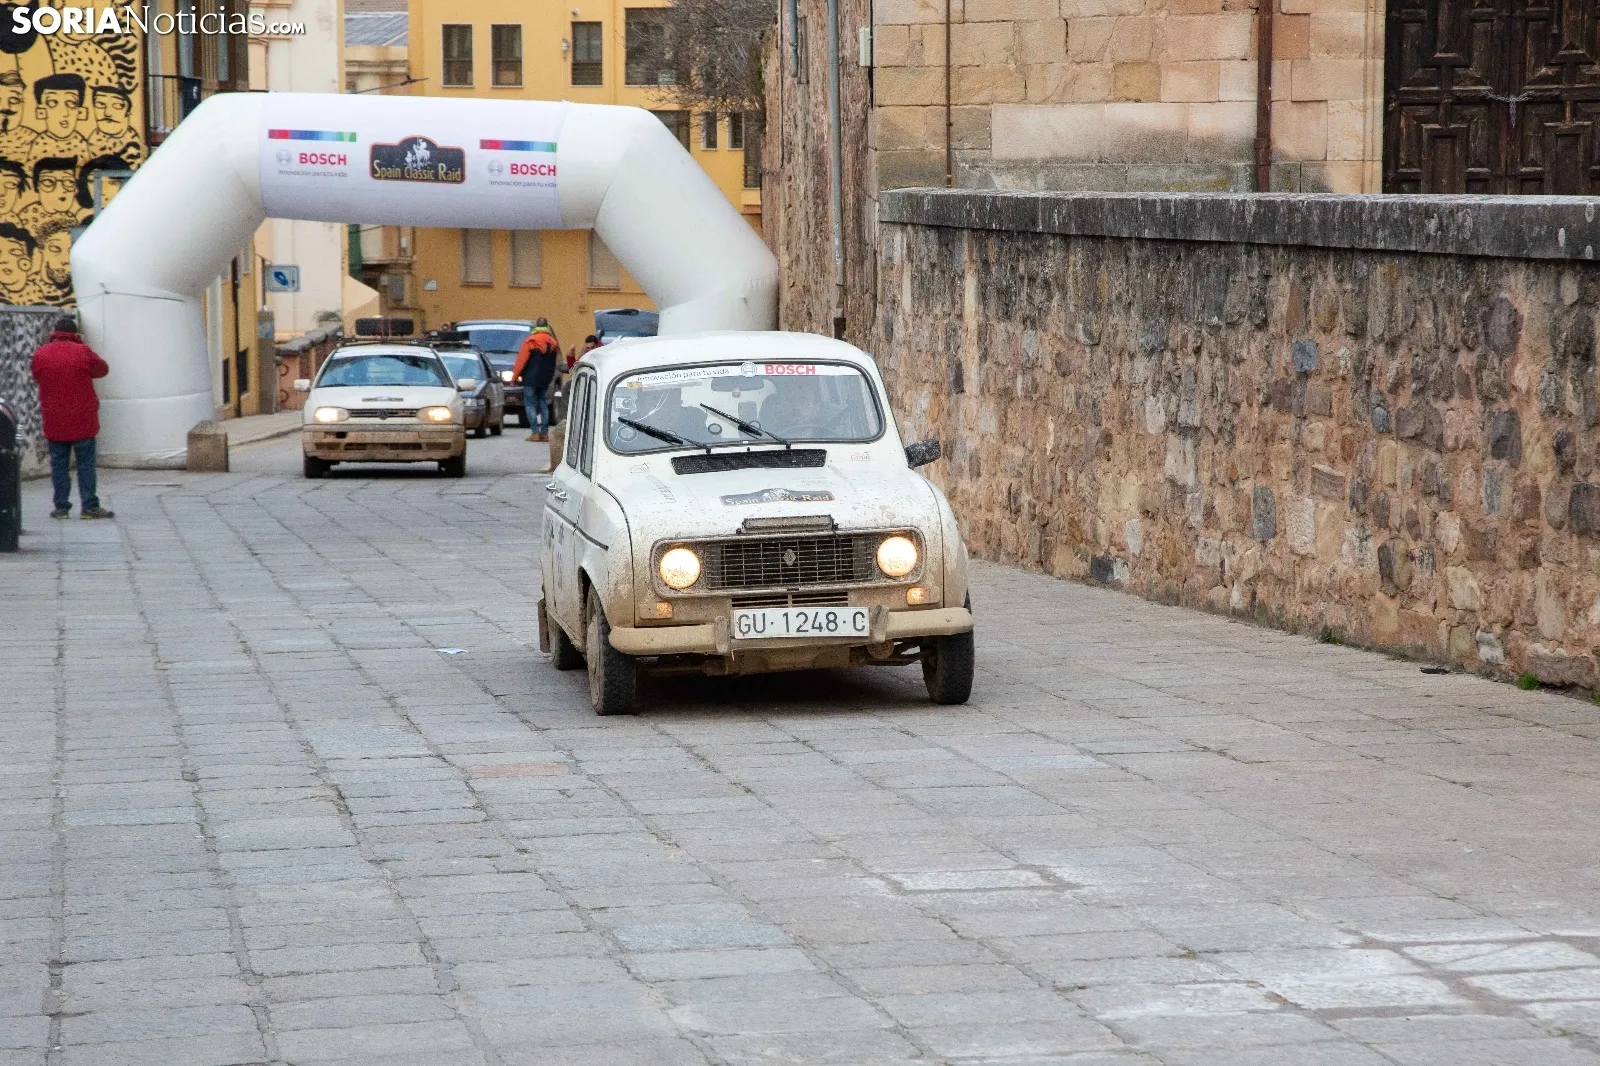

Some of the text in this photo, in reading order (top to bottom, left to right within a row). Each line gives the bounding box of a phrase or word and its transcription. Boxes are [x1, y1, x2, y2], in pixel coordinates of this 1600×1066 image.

[299, 152, 347, 166] BOSCH
[373, 159, 461, 181] Spain Classic Raid
[510, 163, 557, 177] BOSCH
[683, 371, 702, 379] para
[764, 364, 816, 375] BOSCH
[802, 494, 830, 502] Raid
